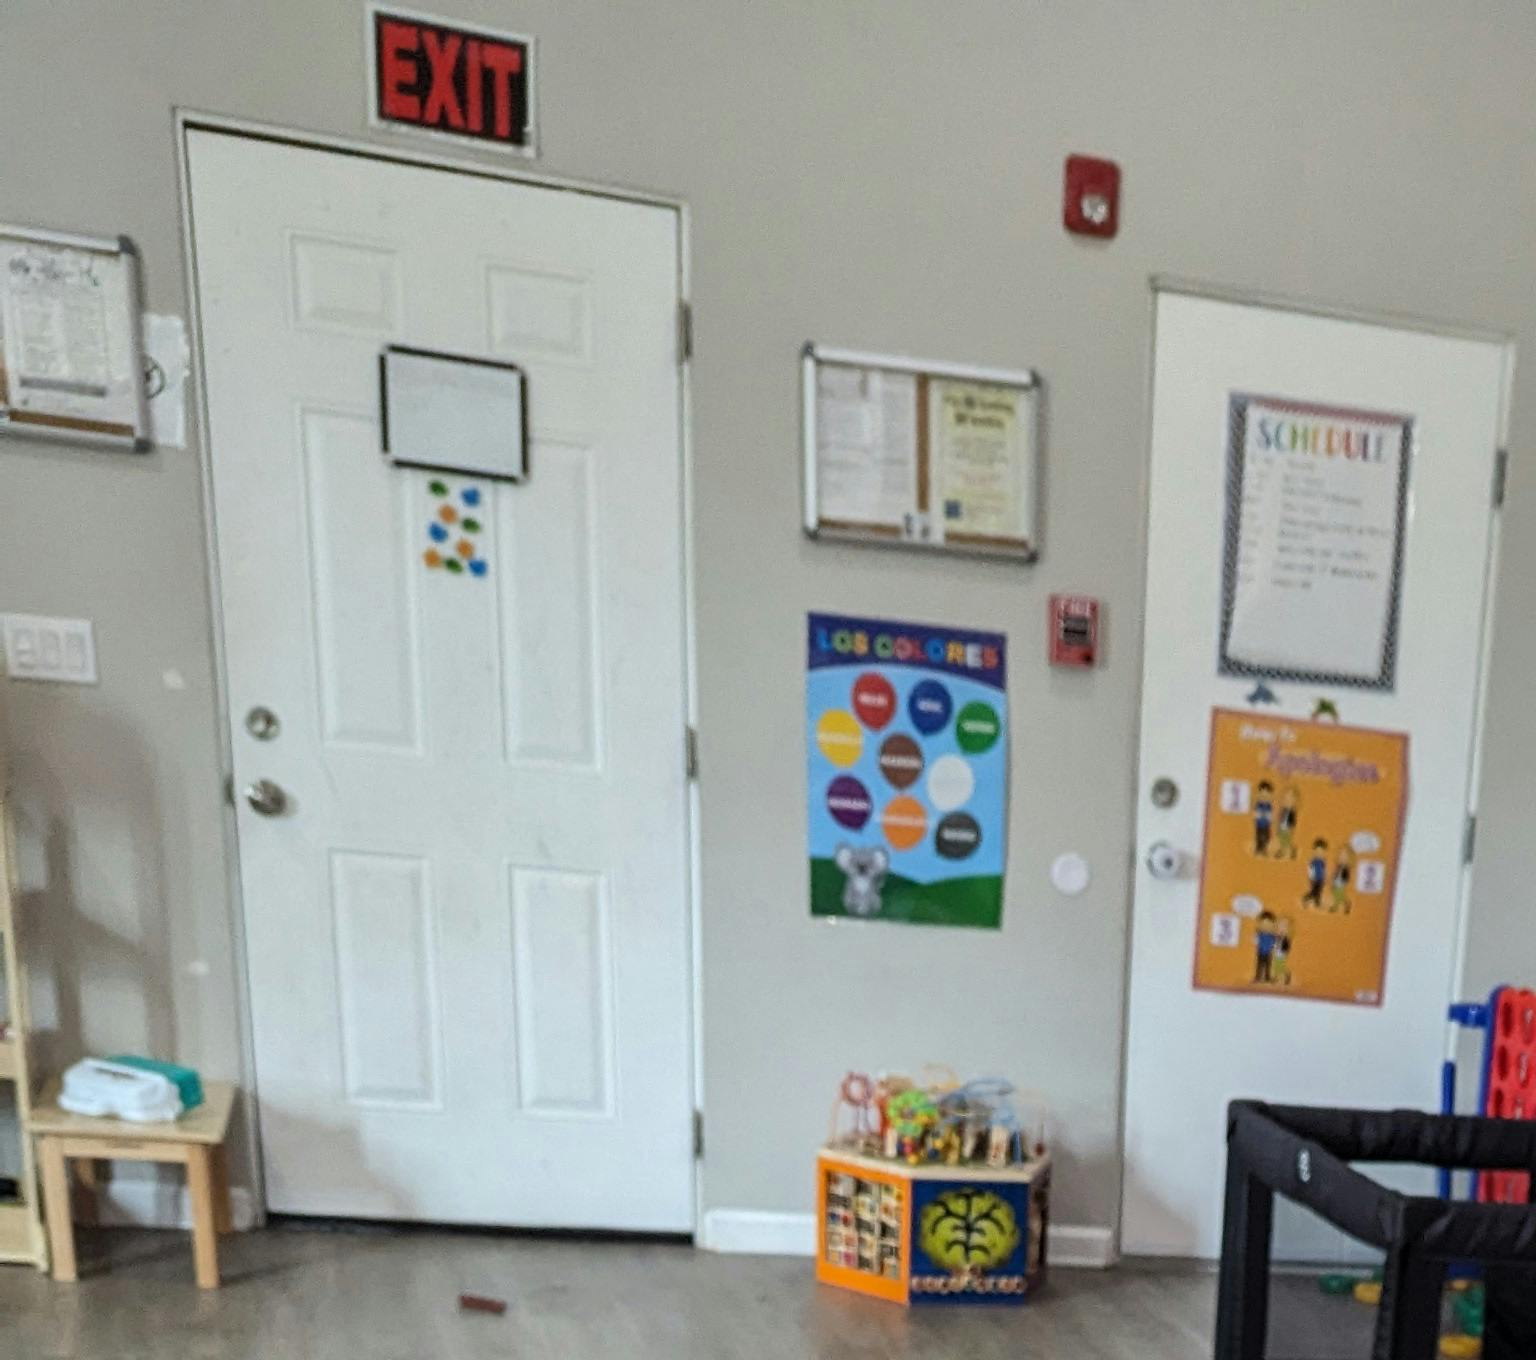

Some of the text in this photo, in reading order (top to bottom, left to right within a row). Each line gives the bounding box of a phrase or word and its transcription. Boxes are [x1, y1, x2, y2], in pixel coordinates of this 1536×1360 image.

[382, 22, 521, 138] EXIT
[1257, 416, 1386, 465] SCHEDULE
[816, 627, 998, 670] LOS COLORES
